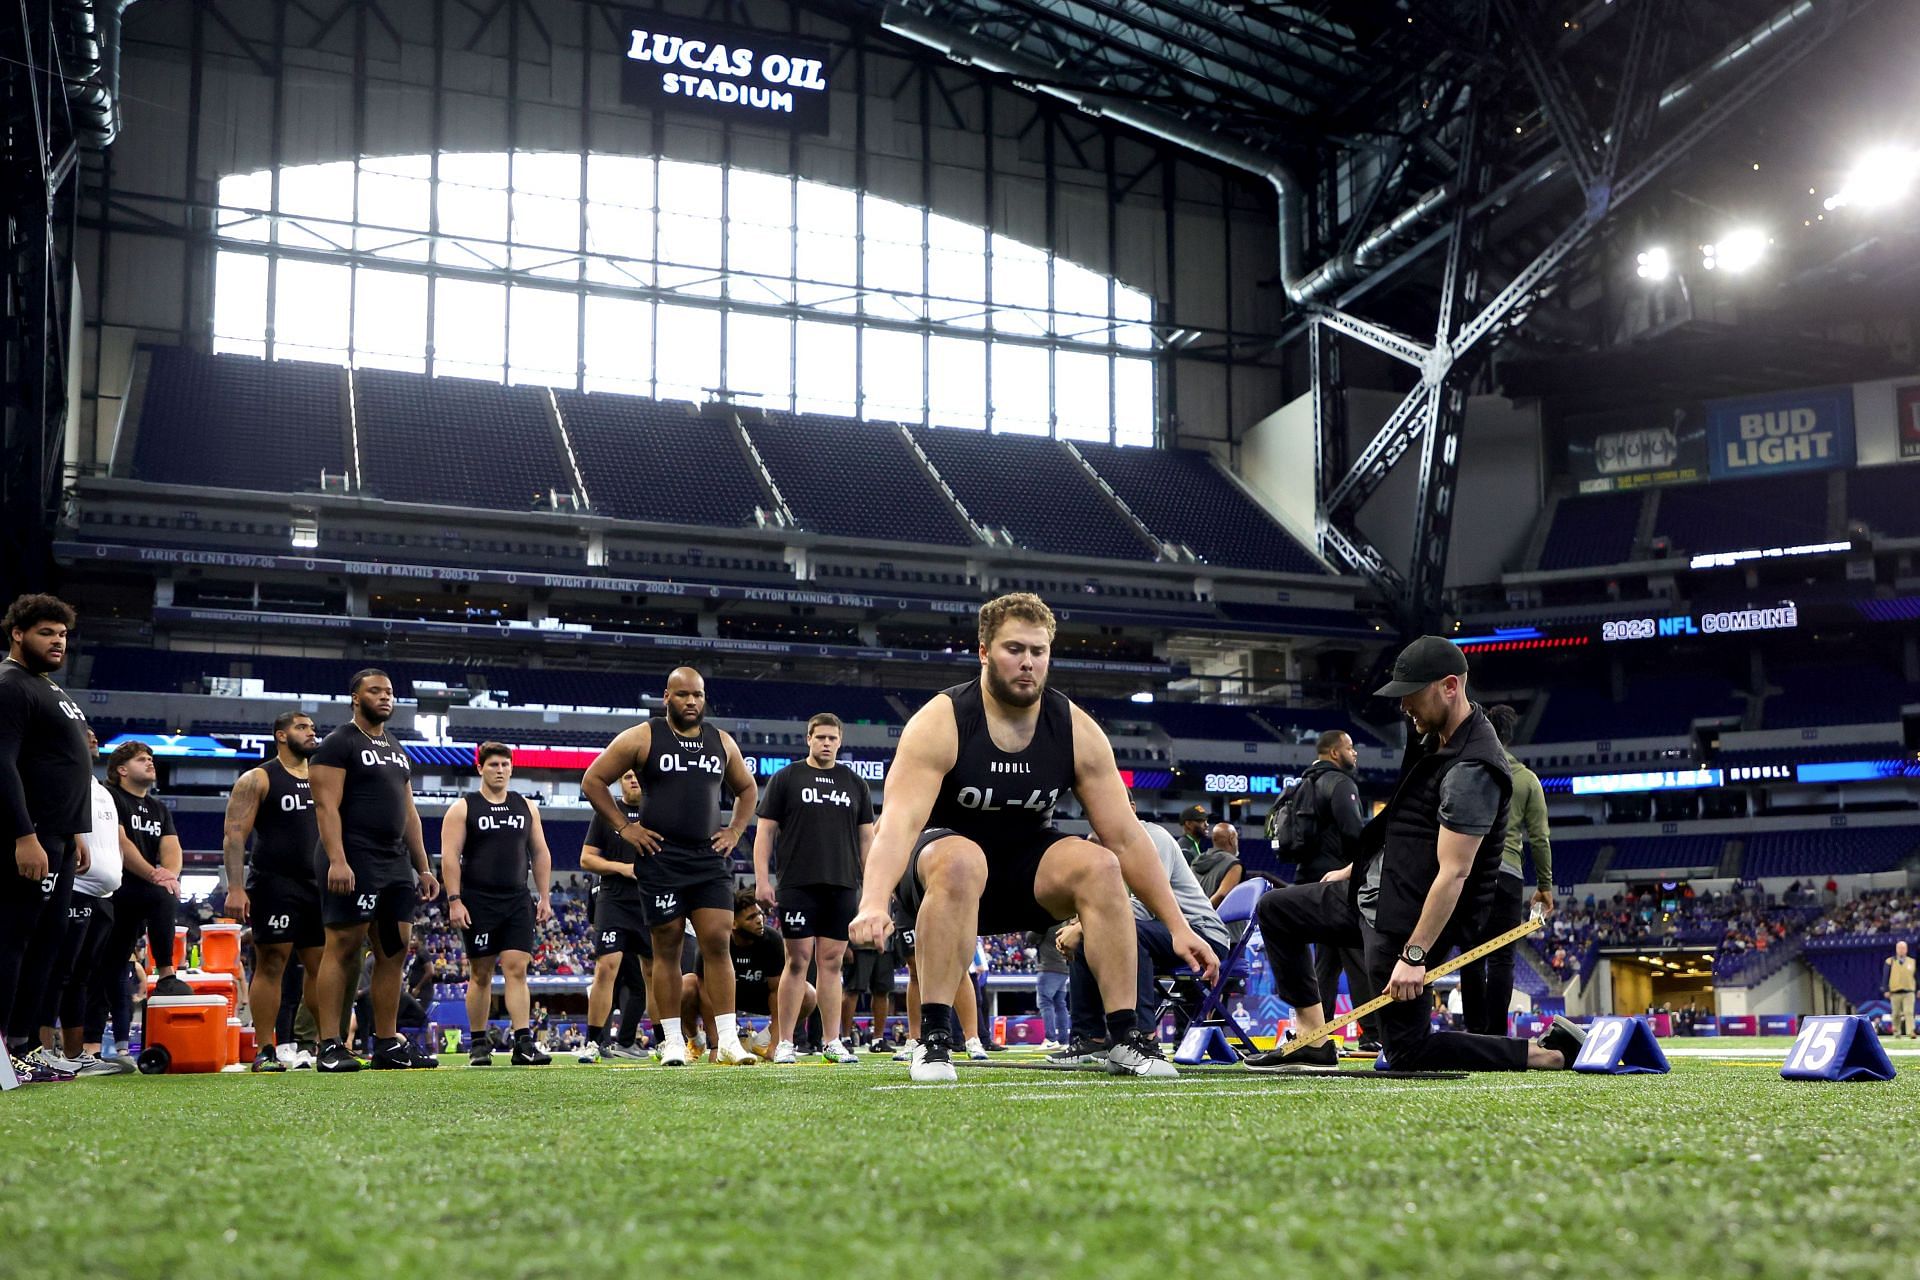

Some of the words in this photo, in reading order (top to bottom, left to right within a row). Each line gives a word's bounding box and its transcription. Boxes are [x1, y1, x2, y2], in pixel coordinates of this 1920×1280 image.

[627, 29, 753, 77] LUCAS
[761, 54, 826, 90] OIL
[663, 72, 793, 113] STADIUM
[1739, 408, 1817, 440] BUD
[1727, 431, 1833, 468] LIGHT
[140, 549, 179, 562] TARIK
[182, 552, 226, 566] GLENN
[345, 562, 388, 576] ROBERT
[392, 565, 434, 579] MATHIS
[544, 576, 587, 590] DWIGHT
[591, 578, 639, 592] FREENEY
[645, 582, 686, 595] 2002-12
[744, 589, 785, 602] PEYTON
[787, 591, 833, 605] MANNING
[930, 601, 966, 613] REGGIE
[1603, 619, 1656, 642] 2023
[1658, 616, 1698, 637] NFL
[1701, 607, 1798, 634] COMBINE
[659, 753, 722, 775] OL-42
[990, 761, 1031, 774] NOBULL
[1205, 773, 1248, 792] 2023
[1250, 776, 1282, 793] NFL
[281, 794, 314, 812] OL-
[801, 787, 851, 807] OL-44
[957, 786, 1057, 811] OL-41
[478, 815, 525, 830] OL-47
[357, 893, 377, 910] 43
[268, 914, 290, 929] 40
[785, 911, 806, 926] 44
[474, 932, 489, 947] 47
[1579, 1016, 1623, 1063] 12
[1794, 1022, 1843, 1071] 15
